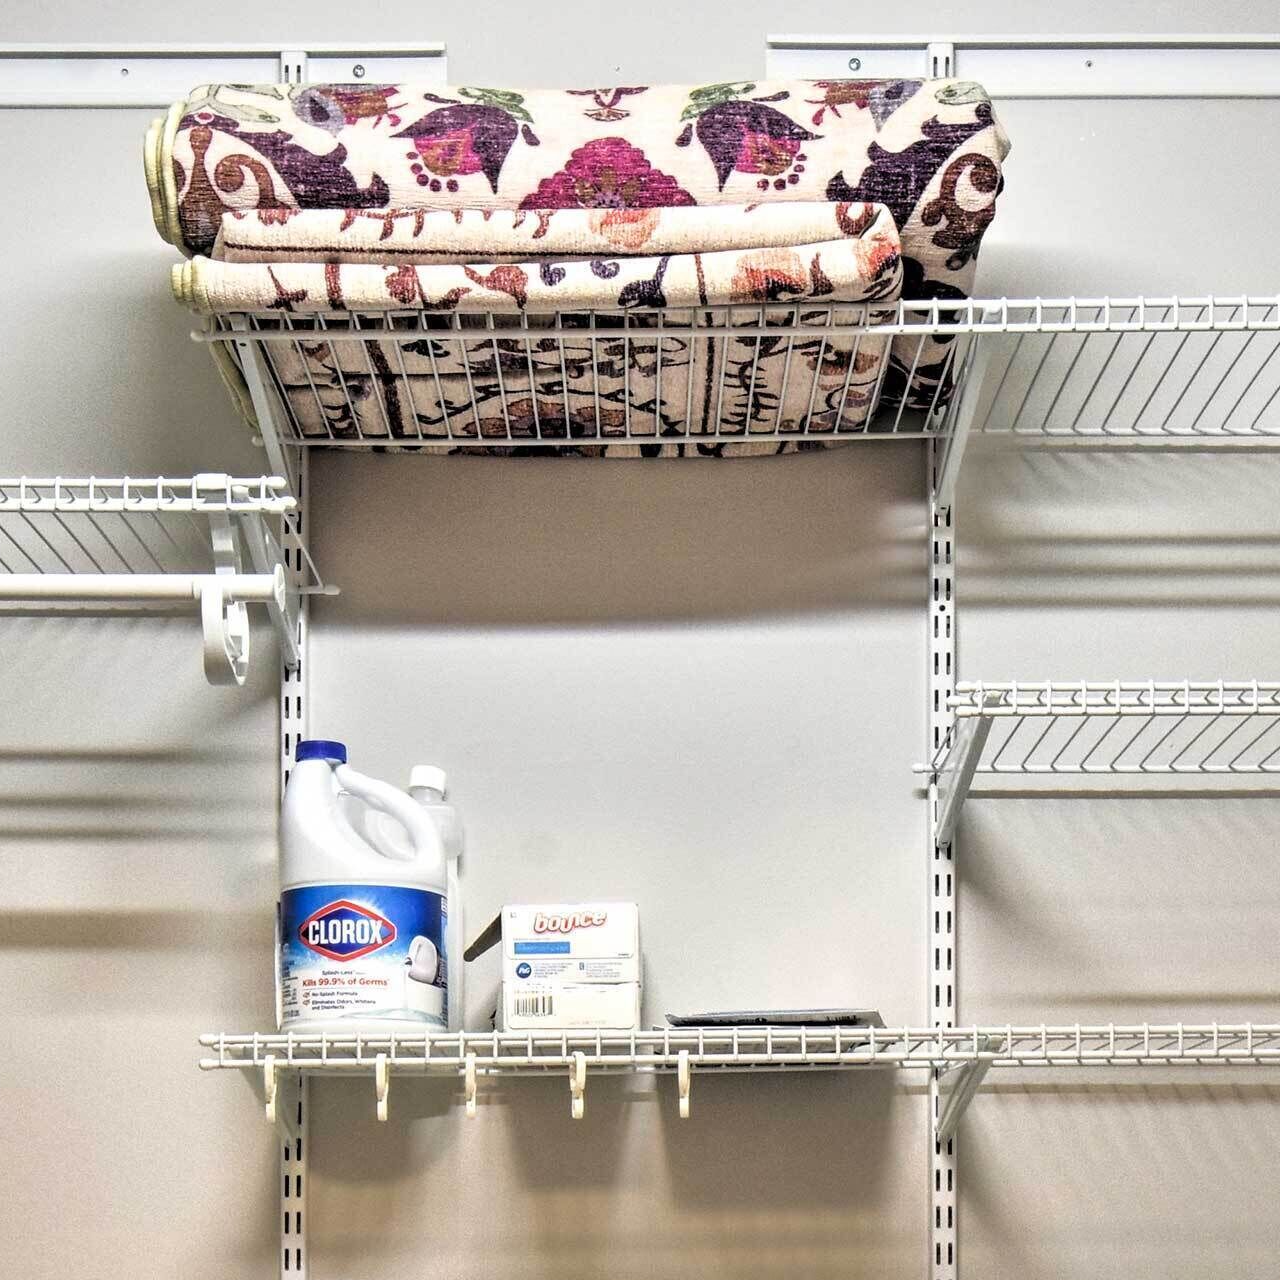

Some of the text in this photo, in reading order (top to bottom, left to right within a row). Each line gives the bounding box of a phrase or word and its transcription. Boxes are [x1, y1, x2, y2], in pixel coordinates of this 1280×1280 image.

[308, 919, 383, 945] CLOROX
[533, 911, 608, 934] bounce
[302, 979, 316, 987] Kills
[318, 978, 345, 986] 99.9%
